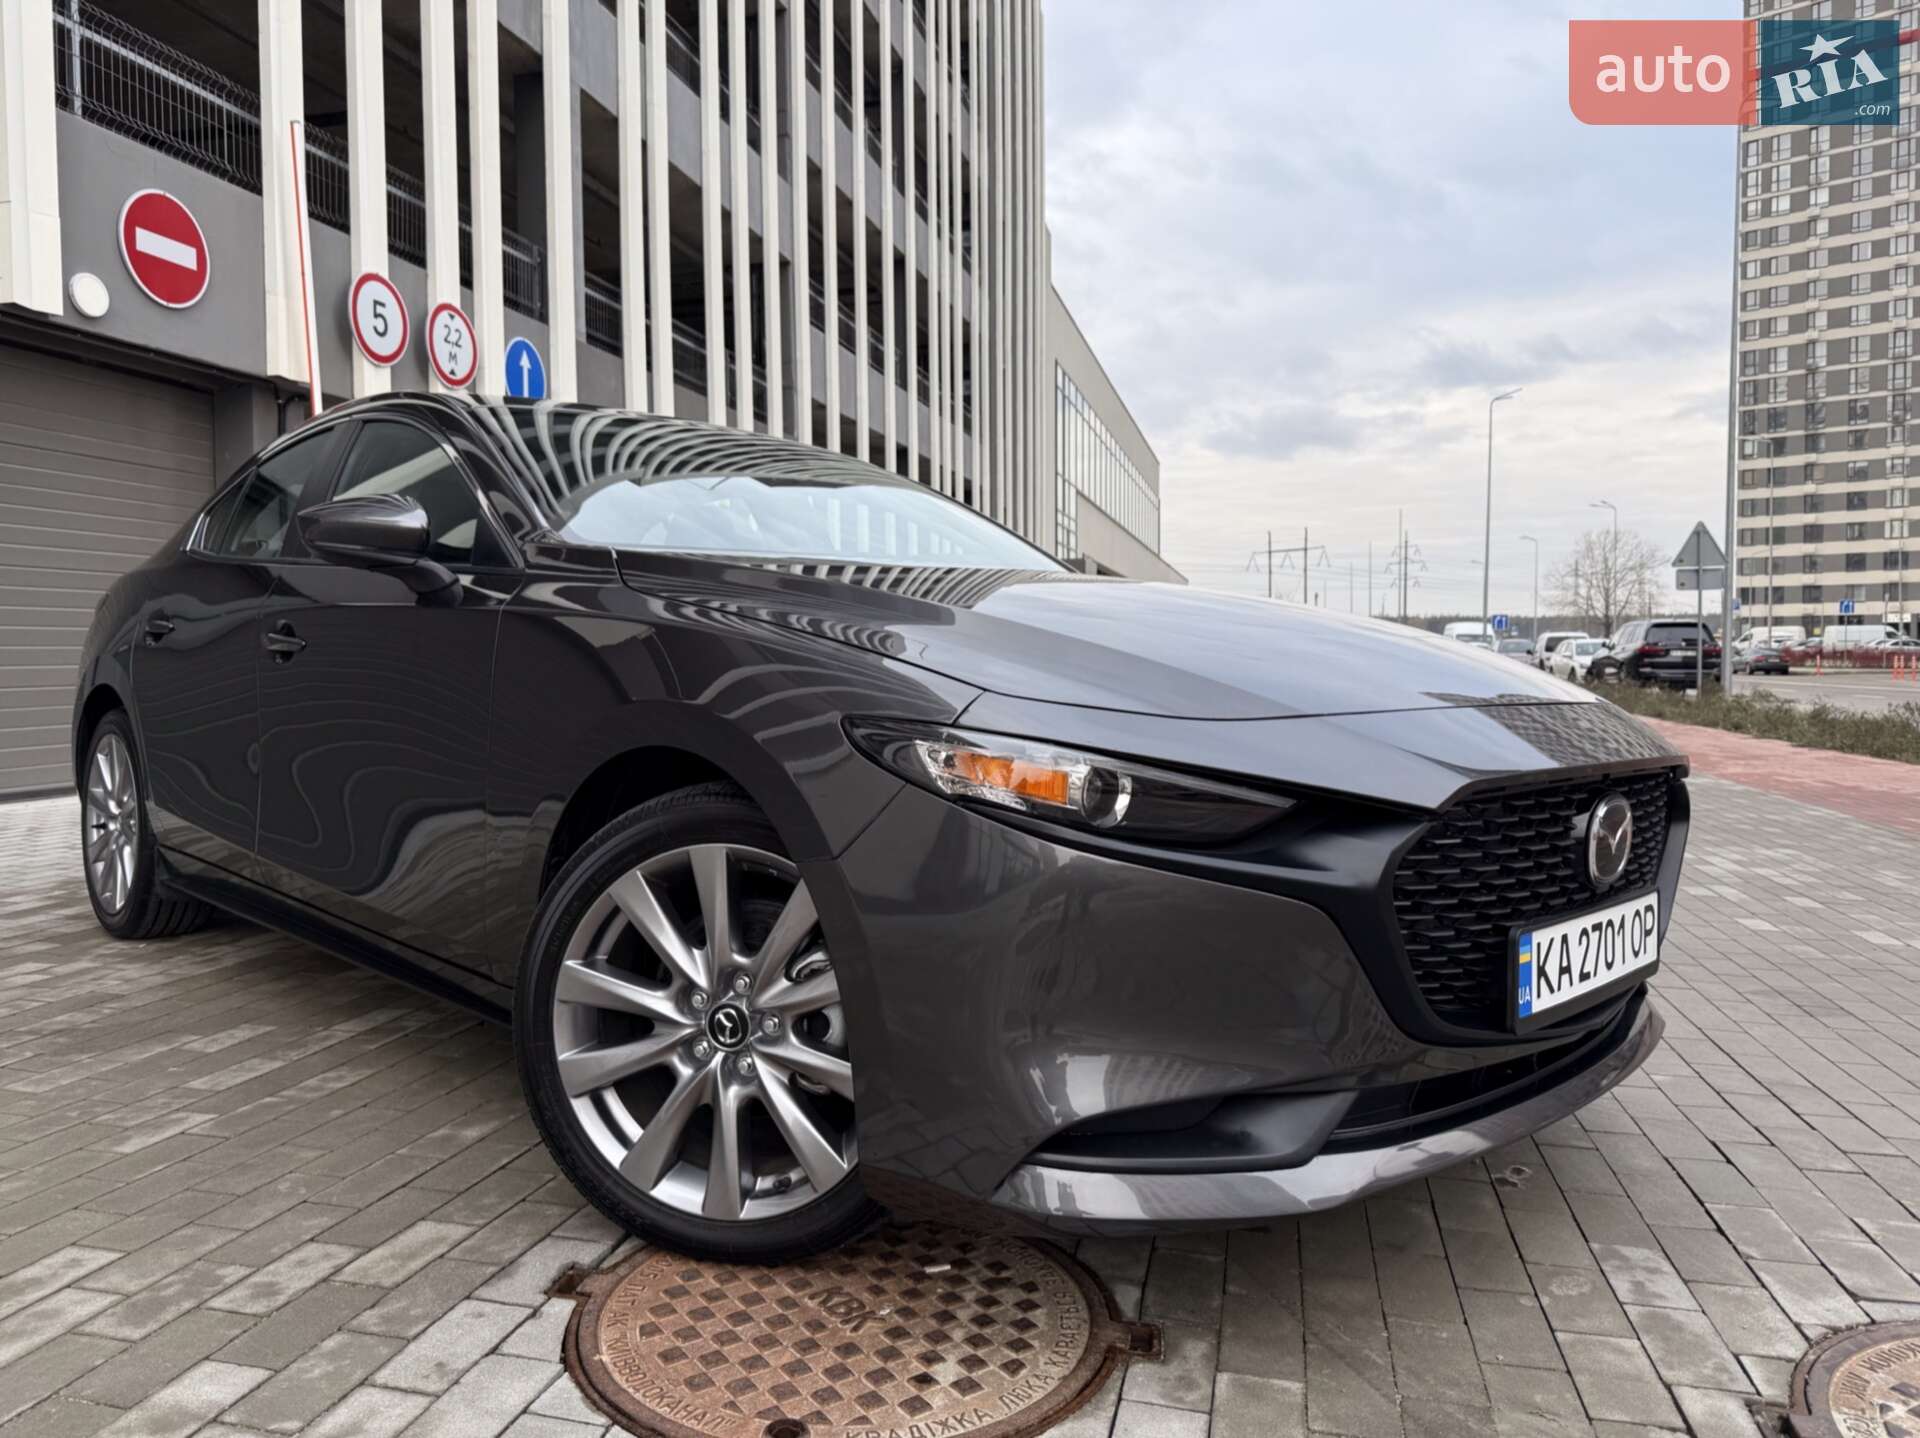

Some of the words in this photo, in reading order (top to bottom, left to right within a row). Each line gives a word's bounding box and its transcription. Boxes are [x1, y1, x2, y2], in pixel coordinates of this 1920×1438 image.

[372, 298, 389, 338] 5
[443, 323, 463, 349] 2,2
[1537, 933, 1574, 999] KA
[1578, 914, 1626, 984] 2701
[1631, 903, 1656, 959] OP
[1518, 986, 1531, 1005] UA
[998, 1373, 1056, 1414] ЛЮКА
